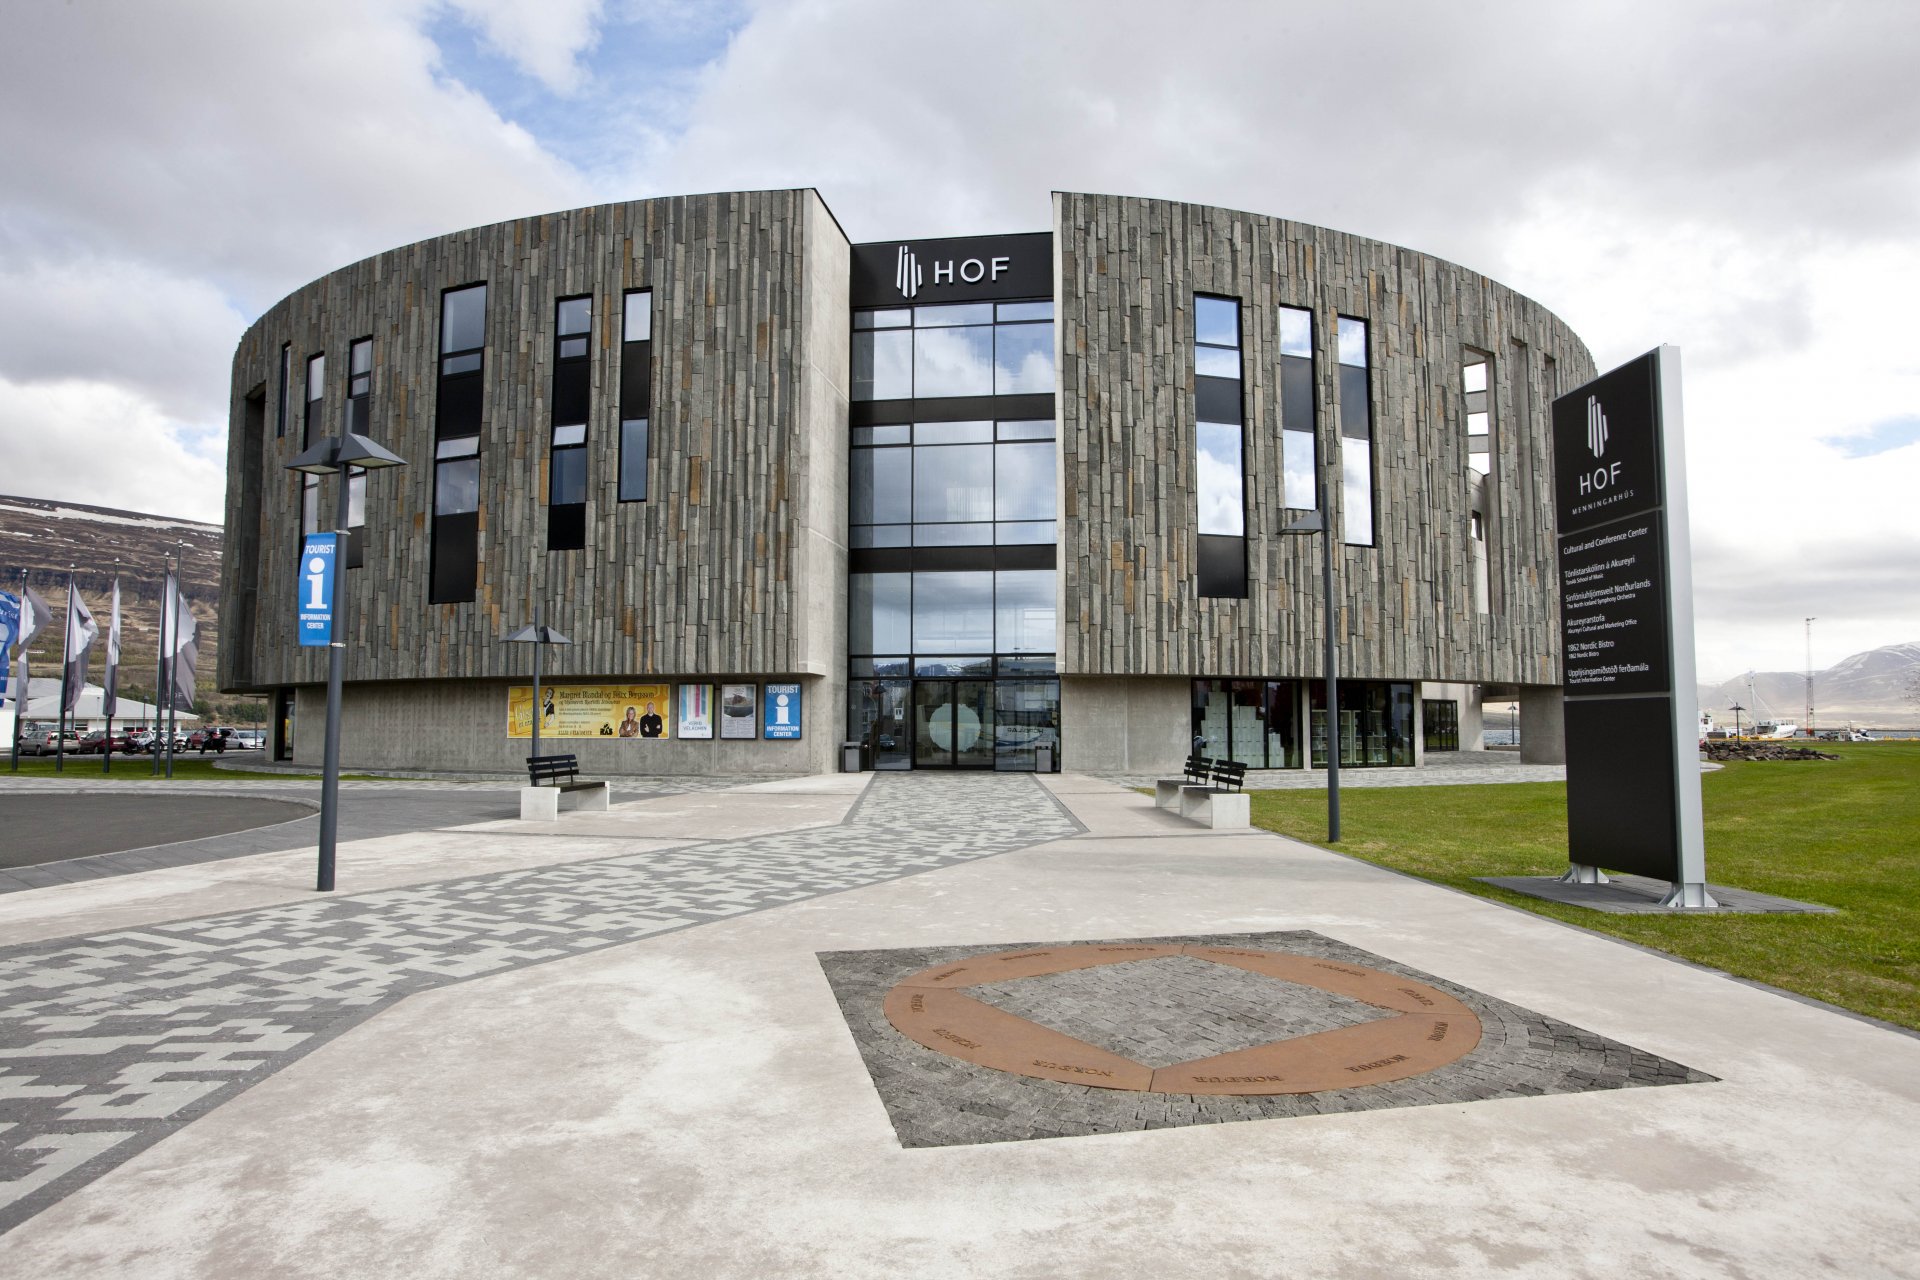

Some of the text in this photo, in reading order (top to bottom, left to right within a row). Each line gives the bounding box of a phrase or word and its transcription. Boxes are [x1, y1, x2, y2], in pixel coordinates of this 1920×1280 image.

[935, 257, 1009, 284] HOF
[1580, 461, 1621, 496] HOF
[1572, 489, 1634, 515] MENNINGARHÚS
[1563, 527, 1648, 555] Cultural and Conference Center
[305, 545, 335, 554] TOURIST
[1611, 555, 1636, 569] Akureyri
[1614, 579, 1651, 593] Norðurlands
[300, 613, 330, 621] INFORMATION
[1580, 641, 1597, 650] Nordic
[1598, 640, 1614, 649] Bistro
[768, 685, 799, 694] TOURIST
